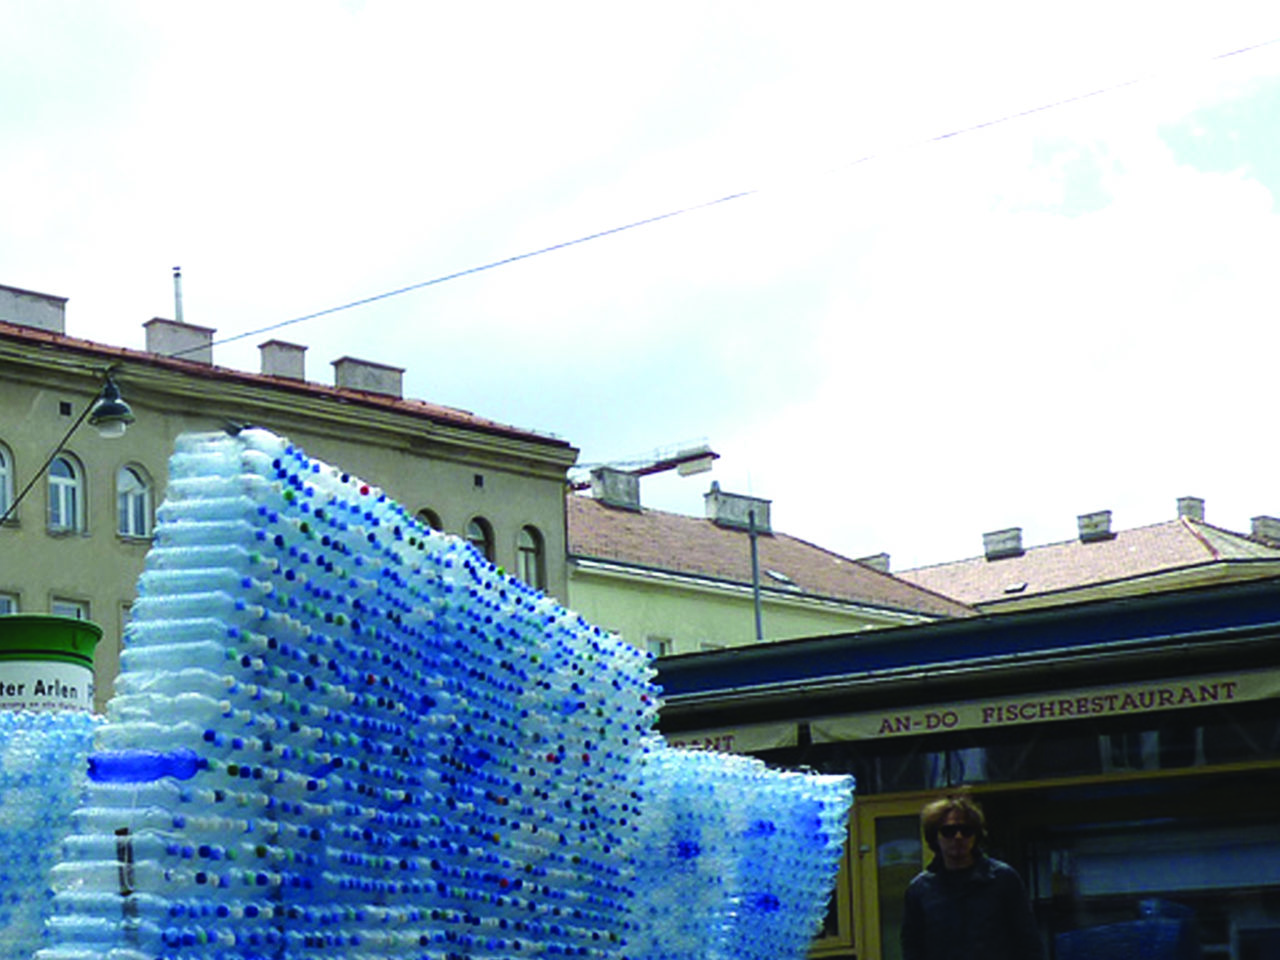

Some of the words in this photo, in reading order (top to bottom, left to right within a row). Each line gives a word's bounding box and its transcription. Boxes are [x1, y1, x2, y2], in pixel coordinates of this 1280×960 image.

[34, 680, 78, 699] Arlen
[879, 711, 958, 734] AN-DO
[981, 682, 1237, 724] FISCHRESTAURANT
